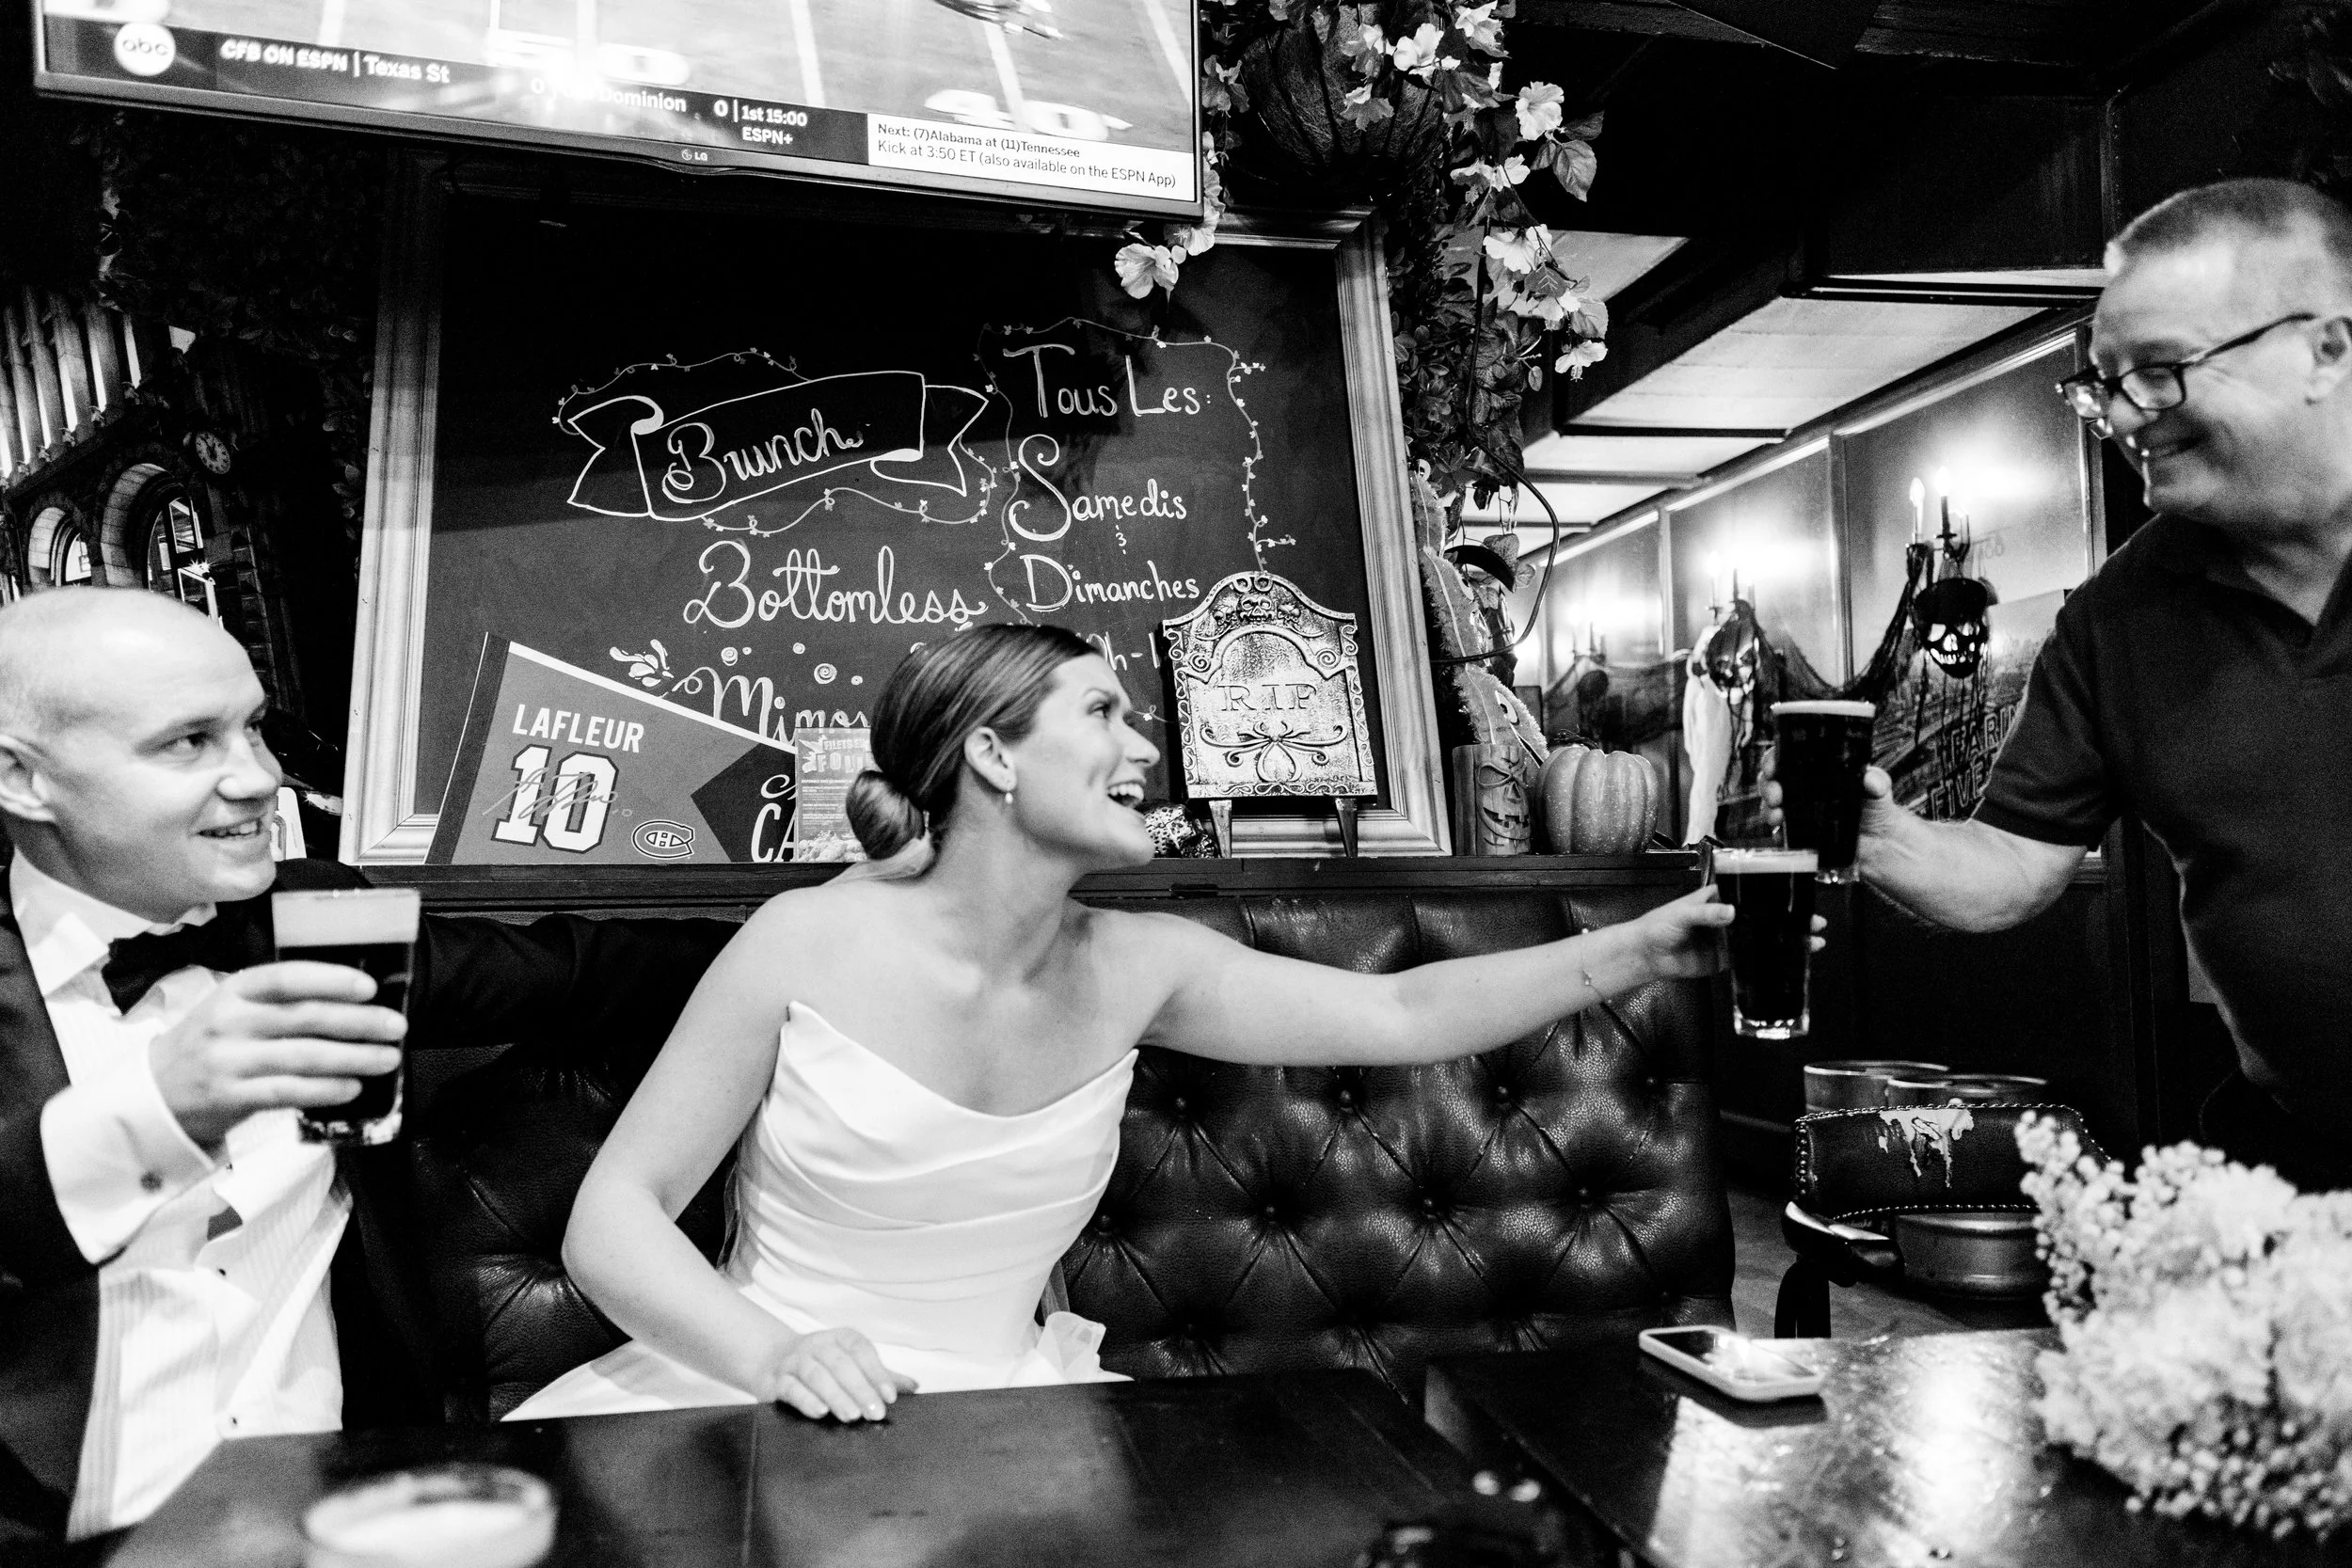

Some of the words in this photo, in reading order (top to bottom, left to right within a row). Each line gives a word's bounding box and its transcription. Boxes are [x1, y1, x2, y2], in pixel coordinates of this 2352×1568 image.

[122, 37, 168, 56] abc
[219, 38, 262, 63] CFB
[262, 43, 294, 66] ON
[295, 47, 348, 72] ESPN
[362, 54, 423, 81] Texas
[425, 62, 451, 84] St
[713, 100, 729, 119] 0
[741, 104, 764, 122] 1st
[765, 105, 808, 128] 15:00
[693, 151, 708, 163] LG
[741, 126, 794, 146] ESPN+
[878, 123, 911, 138] Next:
[914, 127, 983, 149] (7)Alabama
[984, 138, 998, 149] at
[1000, 137, 1081, 159] (11)Tennessee
[877, 141, 908, 156] Kick
[910, 146, 924, 157] at
[926, 145, 957, 162] 3:50
[960, 149, 977, 164] ET
[978, 150, 1011, 168] (also
[1012, 156, 1069, 175] available
[1070, 166, 1087, 177] on
[1089, 163, 1110, 180] the
[1110, 166, 1146, 183] ESPN
[1148, 170, 1177, 189] App)
[1002, 342, 1118, 418] Tous
[660, 407, 862, 504] Brunch
[1008, 434, 1187, 542] Samedis
[683, 537, 988, 629] Bottomless
[1019, 553, 1200, 612] Dimanches
[1216, 683, 1318, 711] RIP
[512, 703, 645, 752] LAFLEUR
[491, 743, 620, 854] 10
